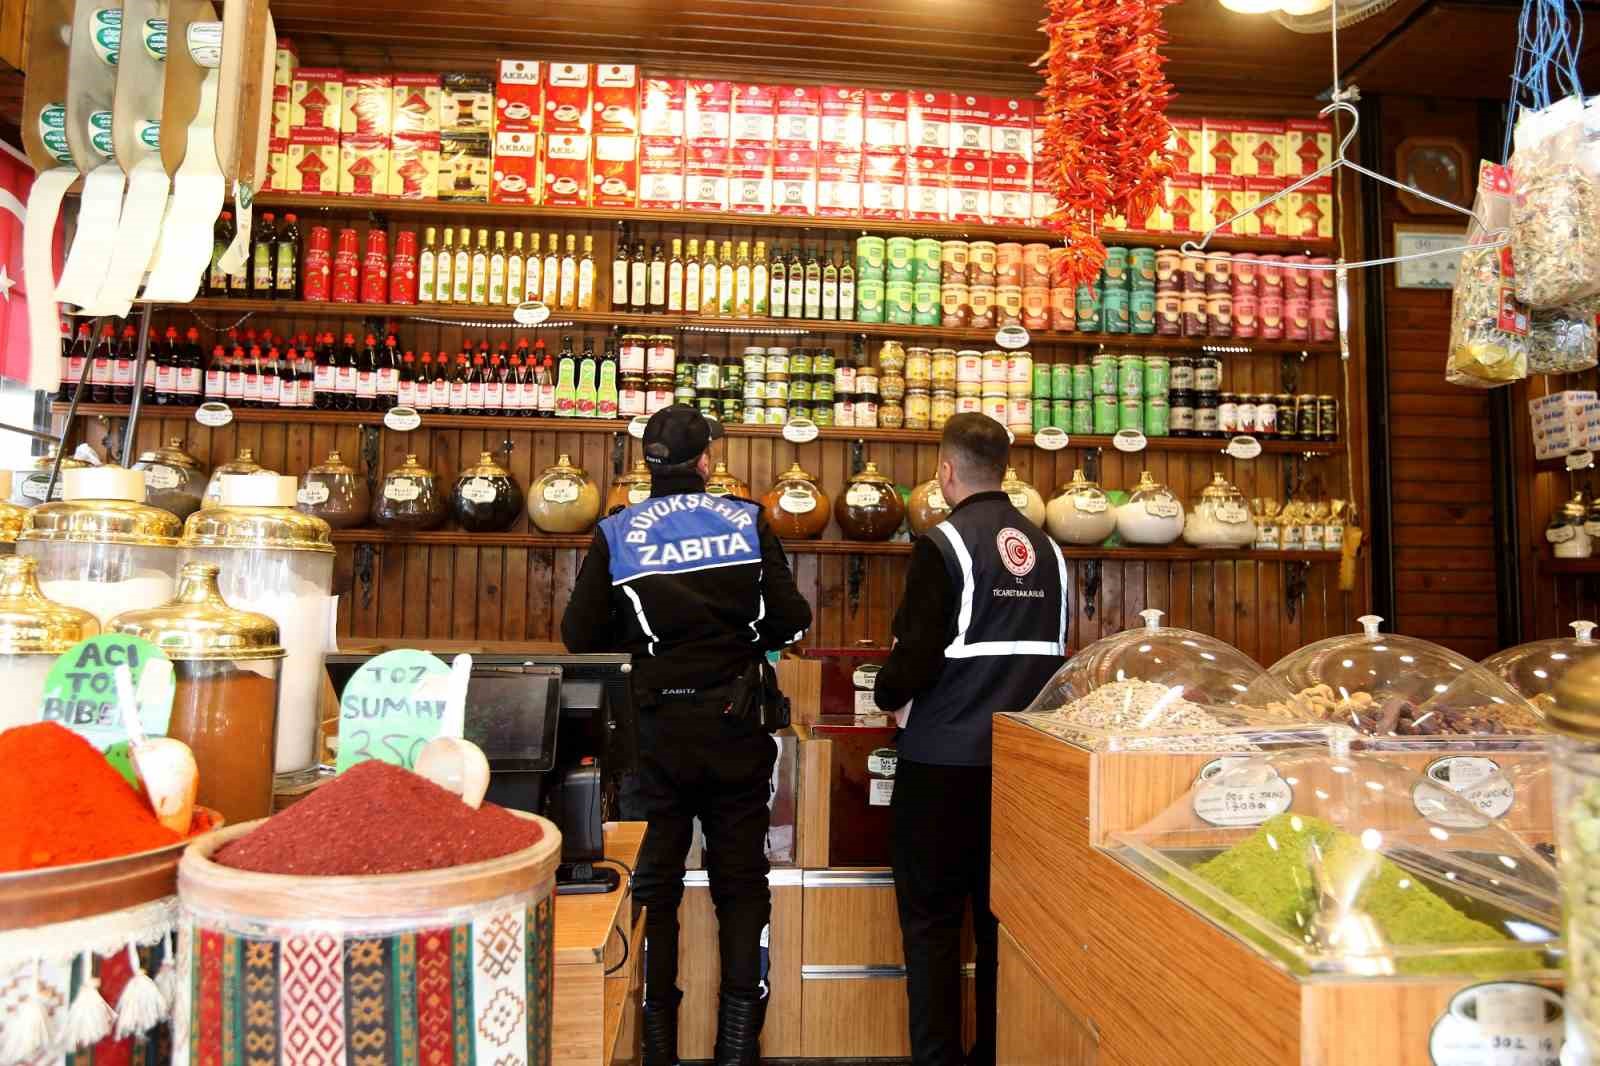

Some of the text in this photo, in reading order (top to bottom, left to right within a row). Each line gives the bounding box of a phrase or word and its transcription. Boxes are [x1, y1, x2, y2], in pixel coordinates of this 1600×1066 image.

[626, 494, 753, 545] BÜYÜKŞEHİR
[638, 531, 752, 566] ZABITA
[75, 642, 139, 668] ACI
[65, 672, 138, 696] TO
[367, 665, 429, 684] TOZ
[42, 694, 144, 727] BİBE
